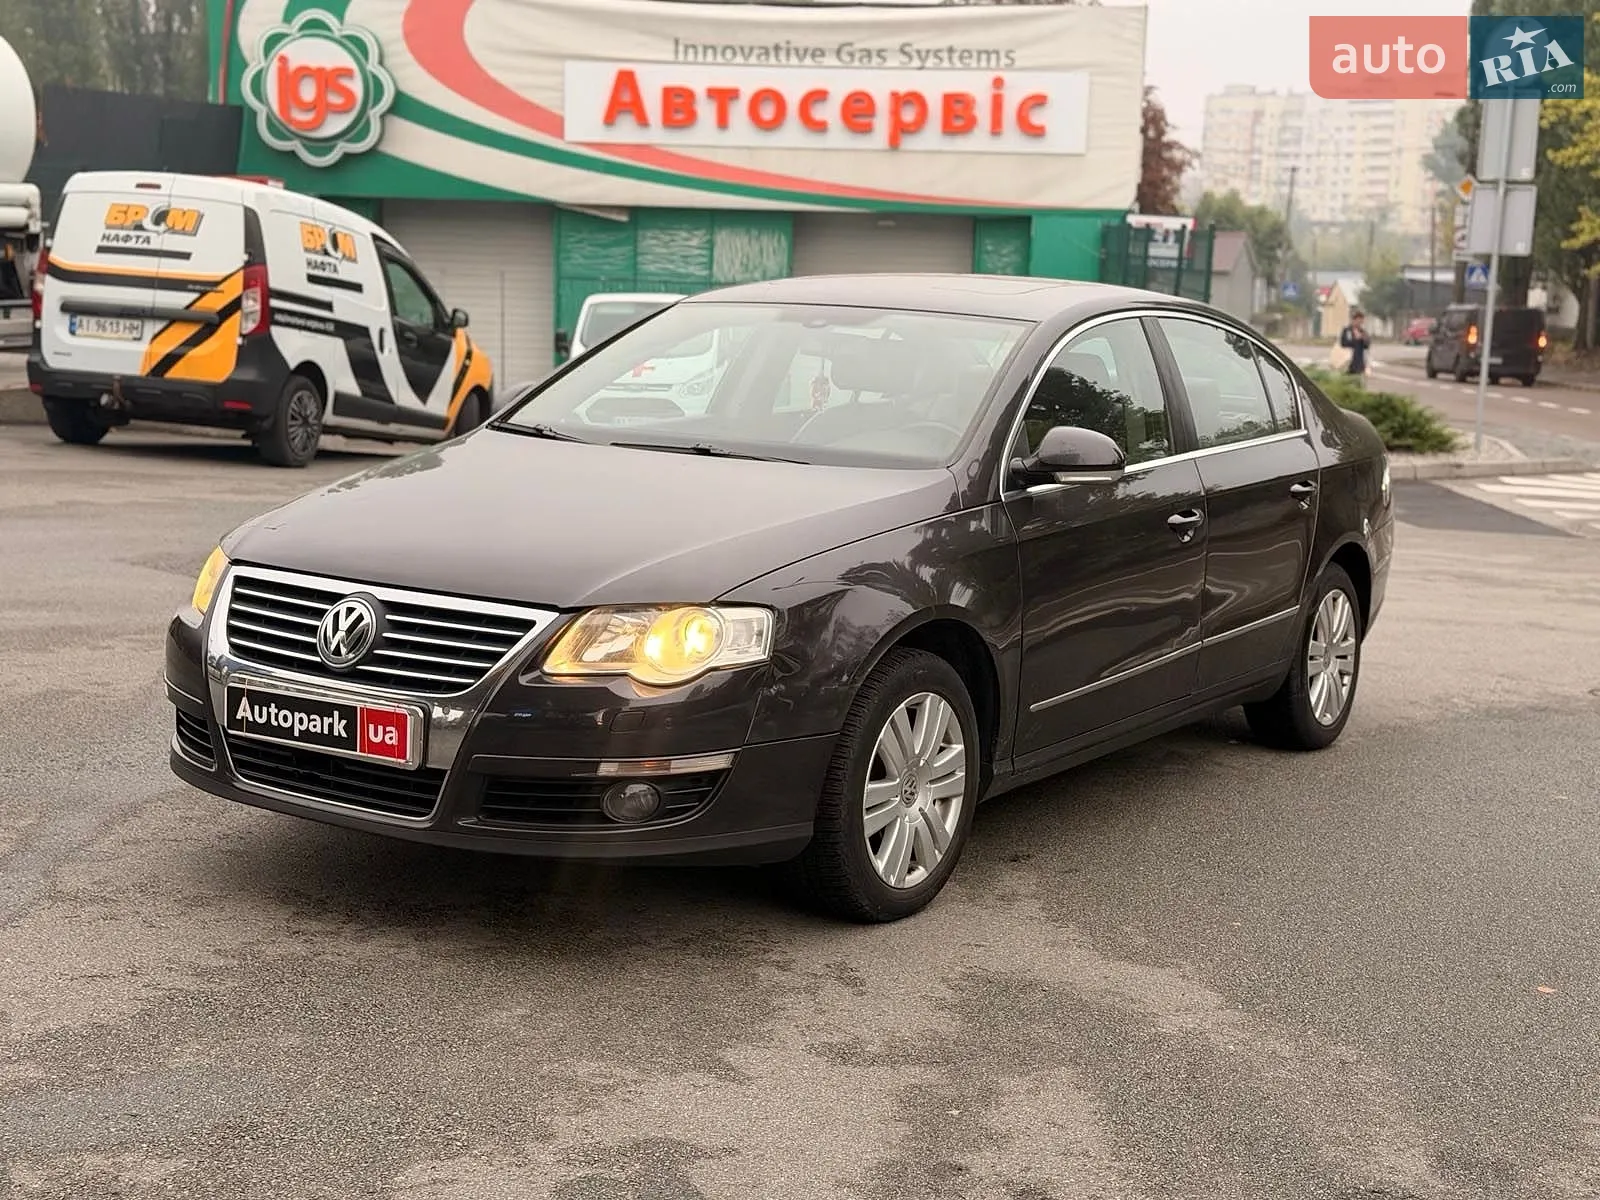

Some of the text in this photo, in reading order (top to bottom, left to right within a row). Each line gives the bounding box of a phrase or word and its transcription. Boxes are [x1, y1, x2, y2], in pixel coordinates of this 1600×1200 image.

[673, 38, 1017, 70] Innovative Gas Systems
[275, 52, 356, 131] igs
[602, 68, 1049, 149] Автосервіс
[100, 232, 152, 246] НАФТА
[305, 257, 340, 275] НАФТА
[235, 696, 399, 746] Autopark ua
